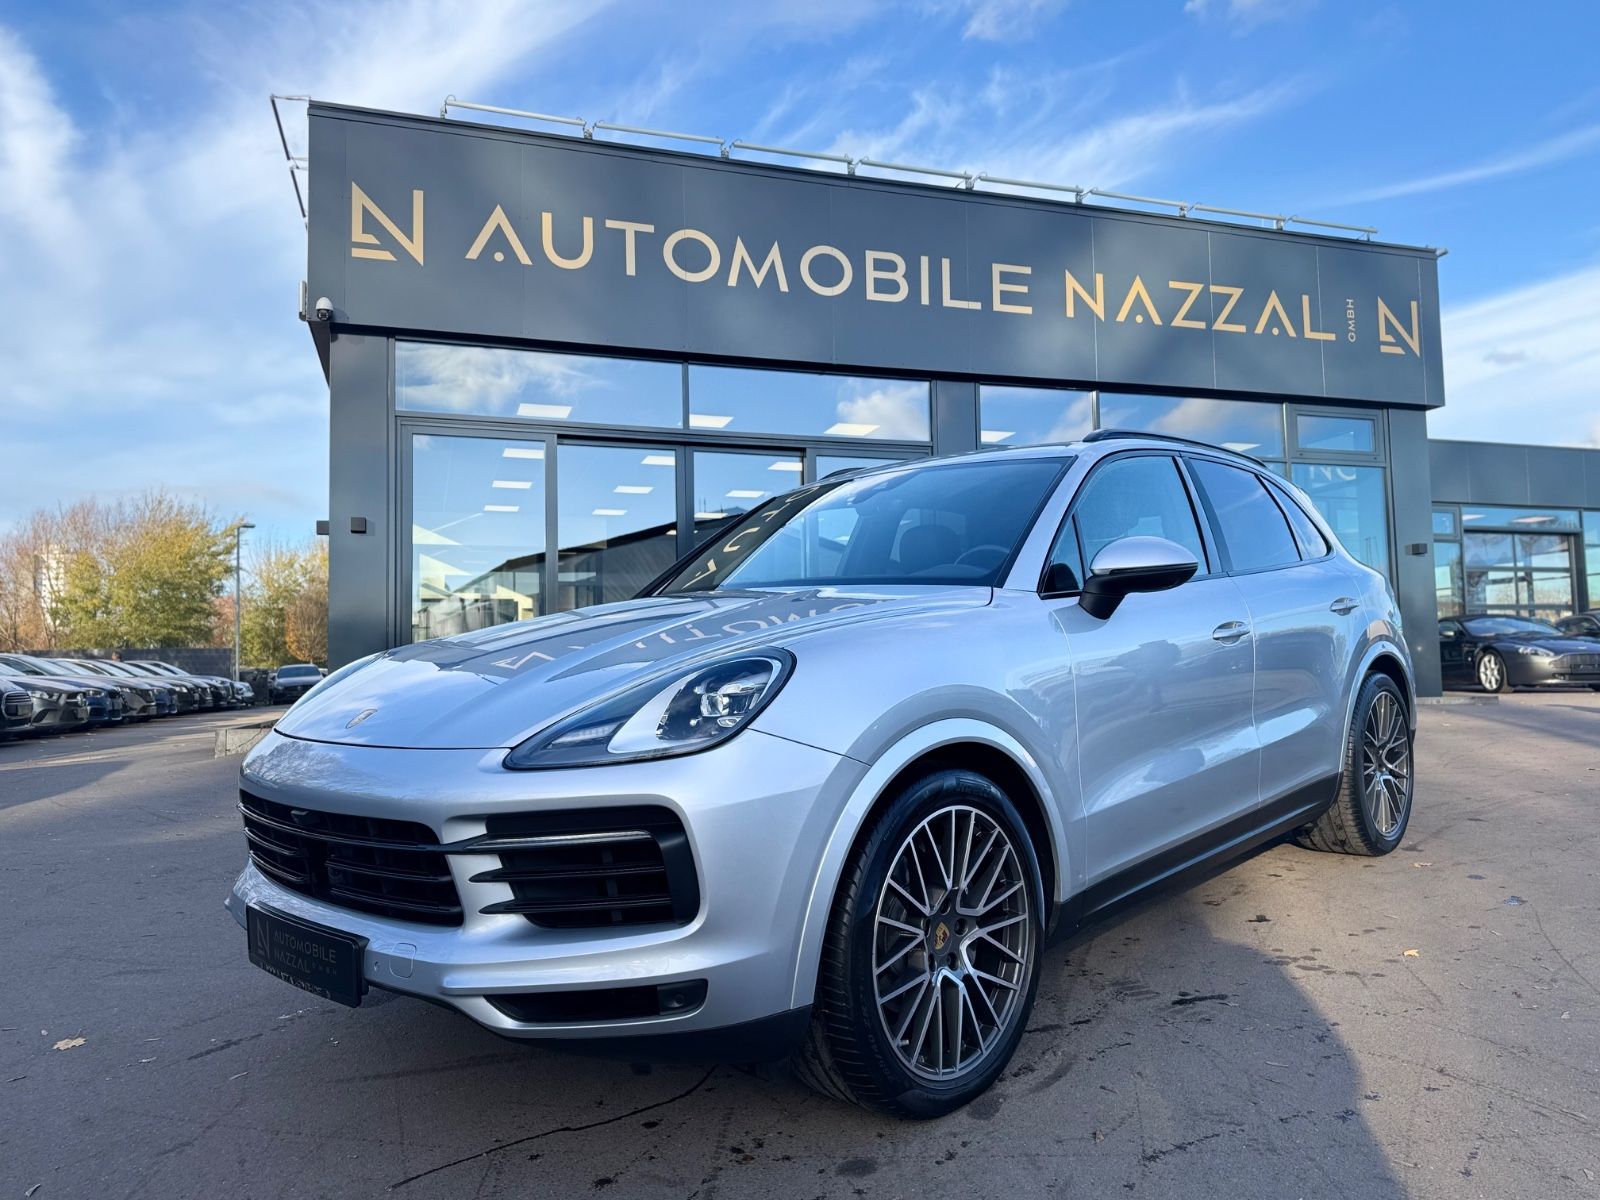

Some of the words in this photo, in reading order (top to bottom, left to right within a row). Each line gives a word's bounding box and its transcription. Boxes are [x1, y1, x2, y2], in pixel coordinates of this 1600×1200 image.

[465, 204, 1033, 315] AUTOMOBILE
[1065, 268, 1336, 341] NAZZAL
[1345, 298, 1357, 343] GMBH
[273, 929, 337, 964] AUTOMOBILE
[273, 948, 311, 974] NAZZAL
